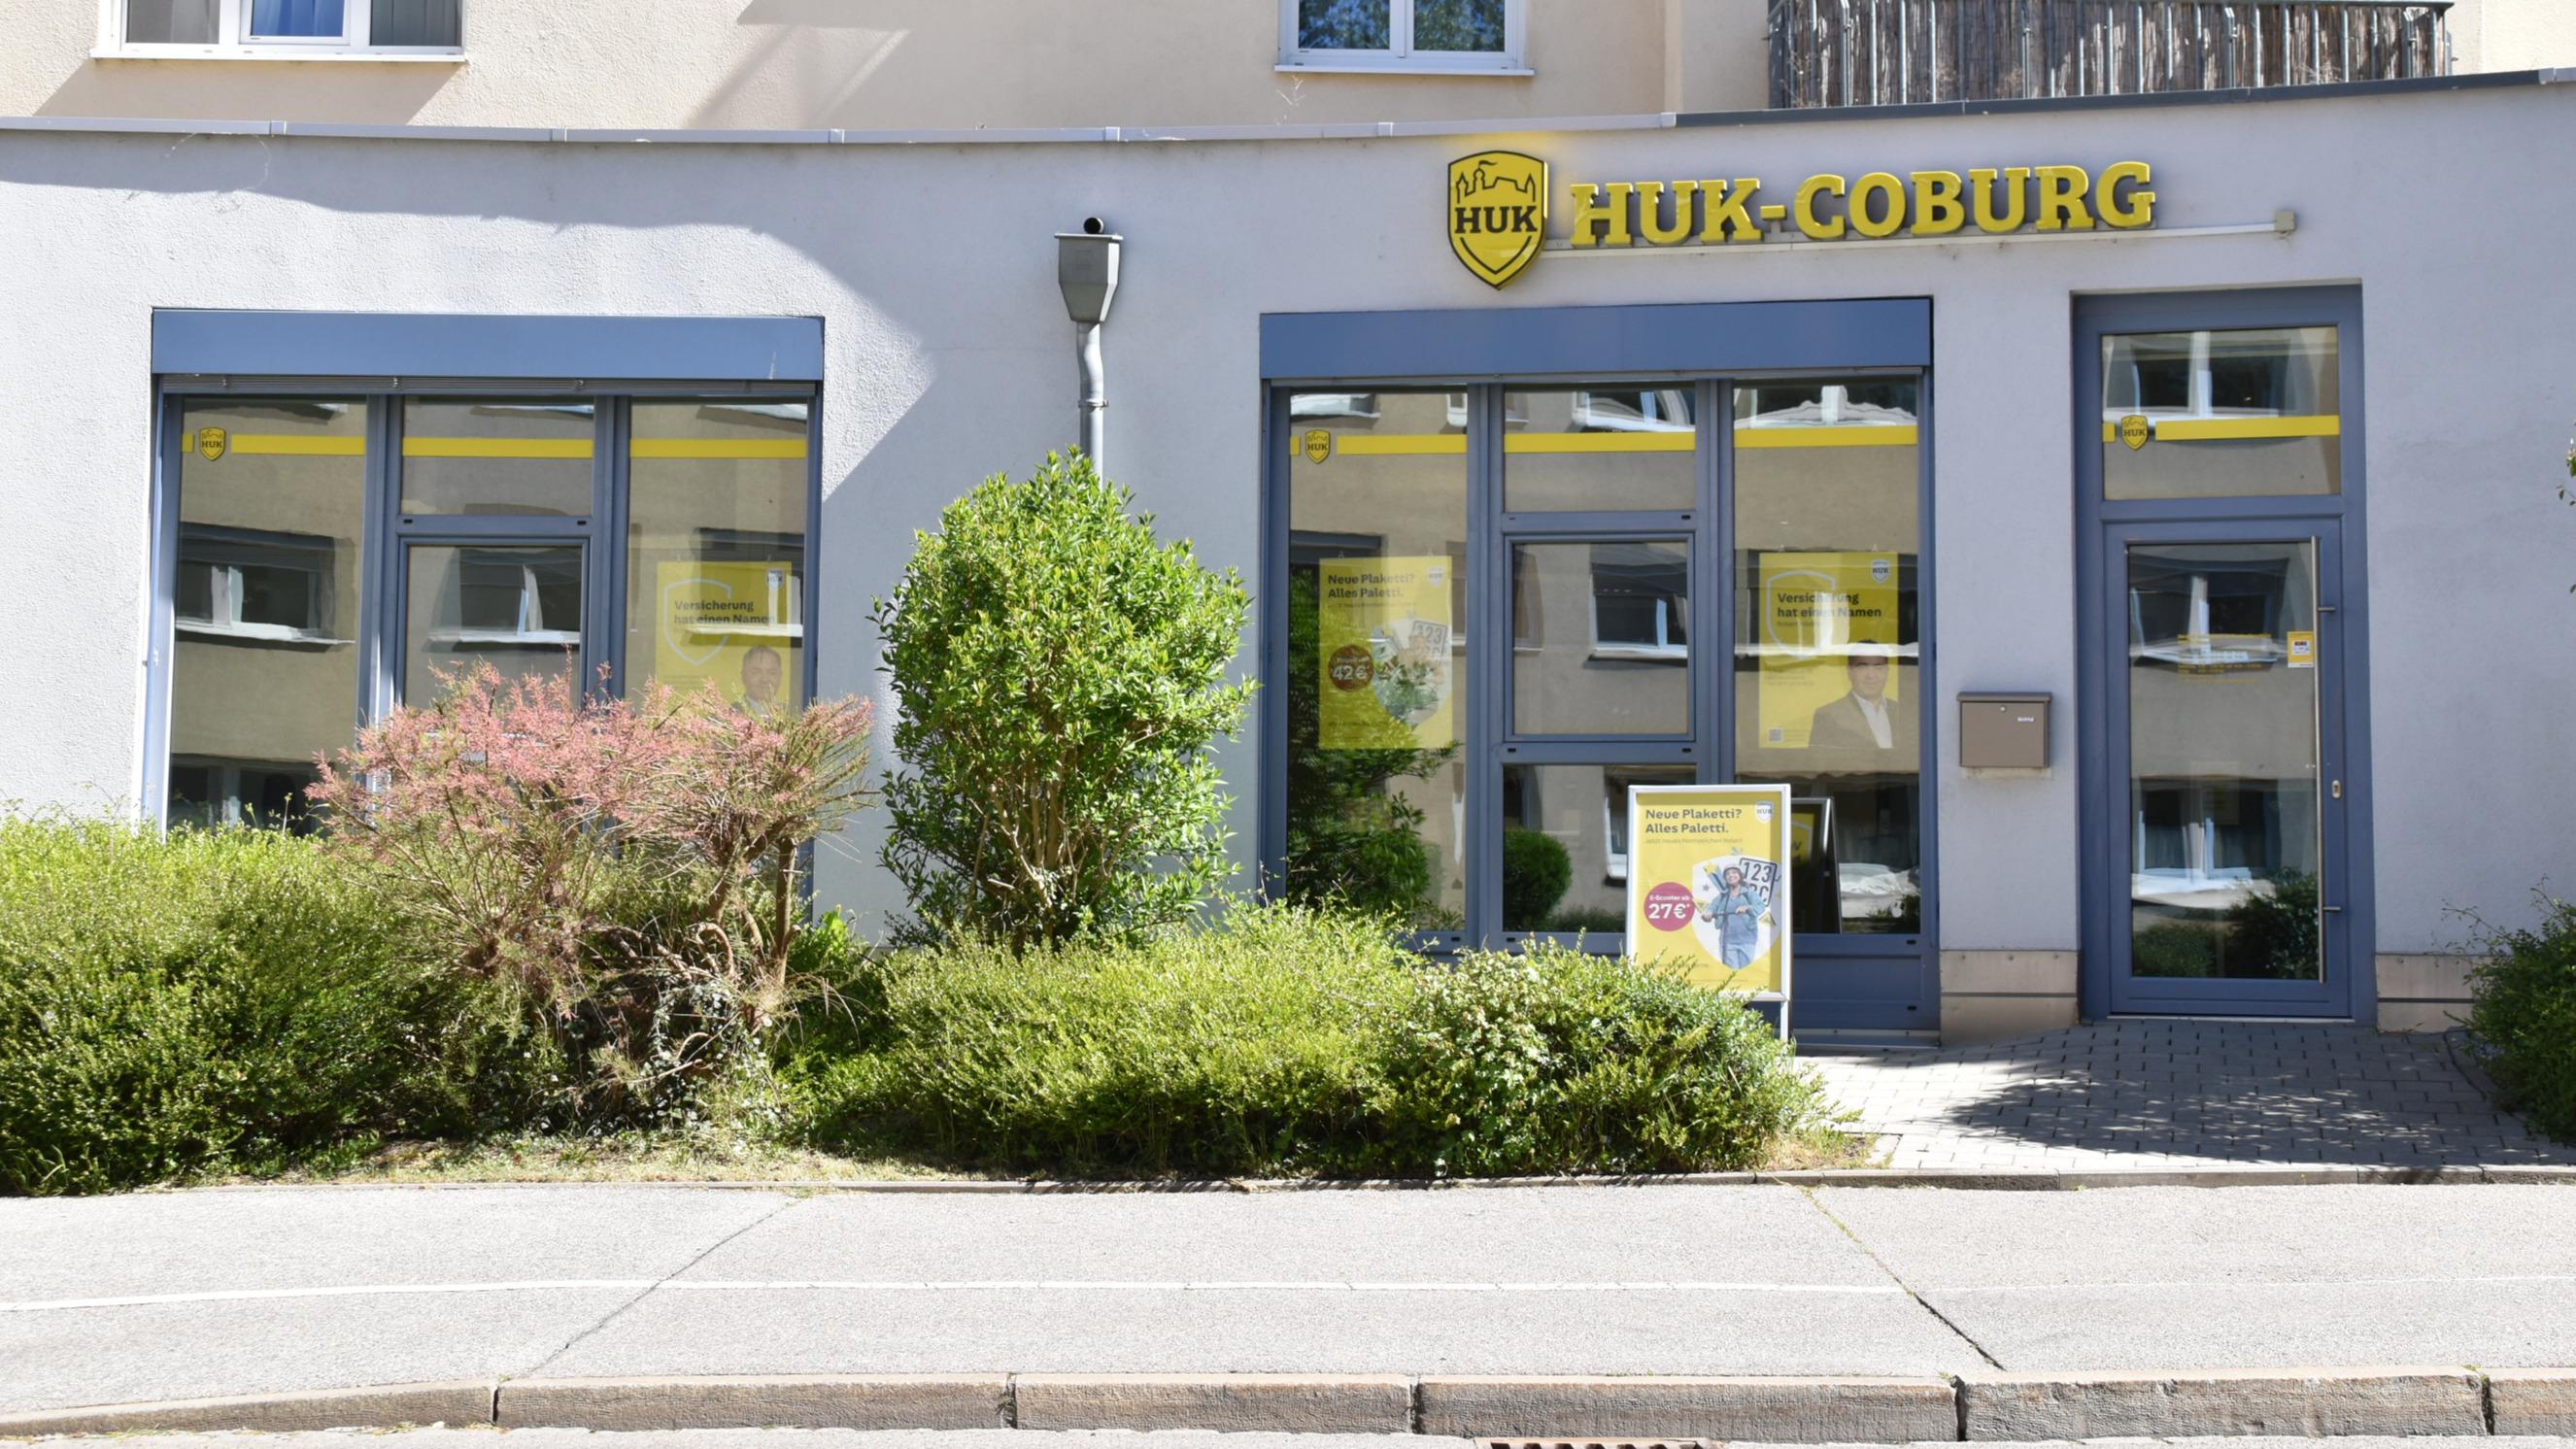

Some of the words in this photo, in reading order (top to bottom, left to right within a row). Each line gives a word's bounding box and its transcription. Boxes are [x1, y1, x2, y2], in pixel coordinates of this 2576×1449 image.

[1570, 161, 2155, 248] HUK-COBURG
[1454, 205, 1539, 234] HUK
[2123, 428, 2146, 437] HUK
[201, 440, 223, 449] HUK
[1328, 574, 1358, 584] Neue
[1361, 573, 1415, 584] Plaketti?
[1328, 588, 1357, 598] Alles
[1361, 588, 1404, 598] Paletti.
[674, 600, 754, 612] Versicherung
[1778, 607, 1798, 617] hat
[1838, 608, 1881, 617] Namen
[674, 614, 695, 623] hat
[696, 615, 729, 623] einen
[733, 615, 774, 623] Namen
[1645, 809, 1679, 819] Neue
[1682, 808, 1742, 820] Plaketti?
[1645, 824, 1678, 833] Alles
[1681, 824, 1729, 833] Paletti.
[1743, 861, 1773, 883] 123
